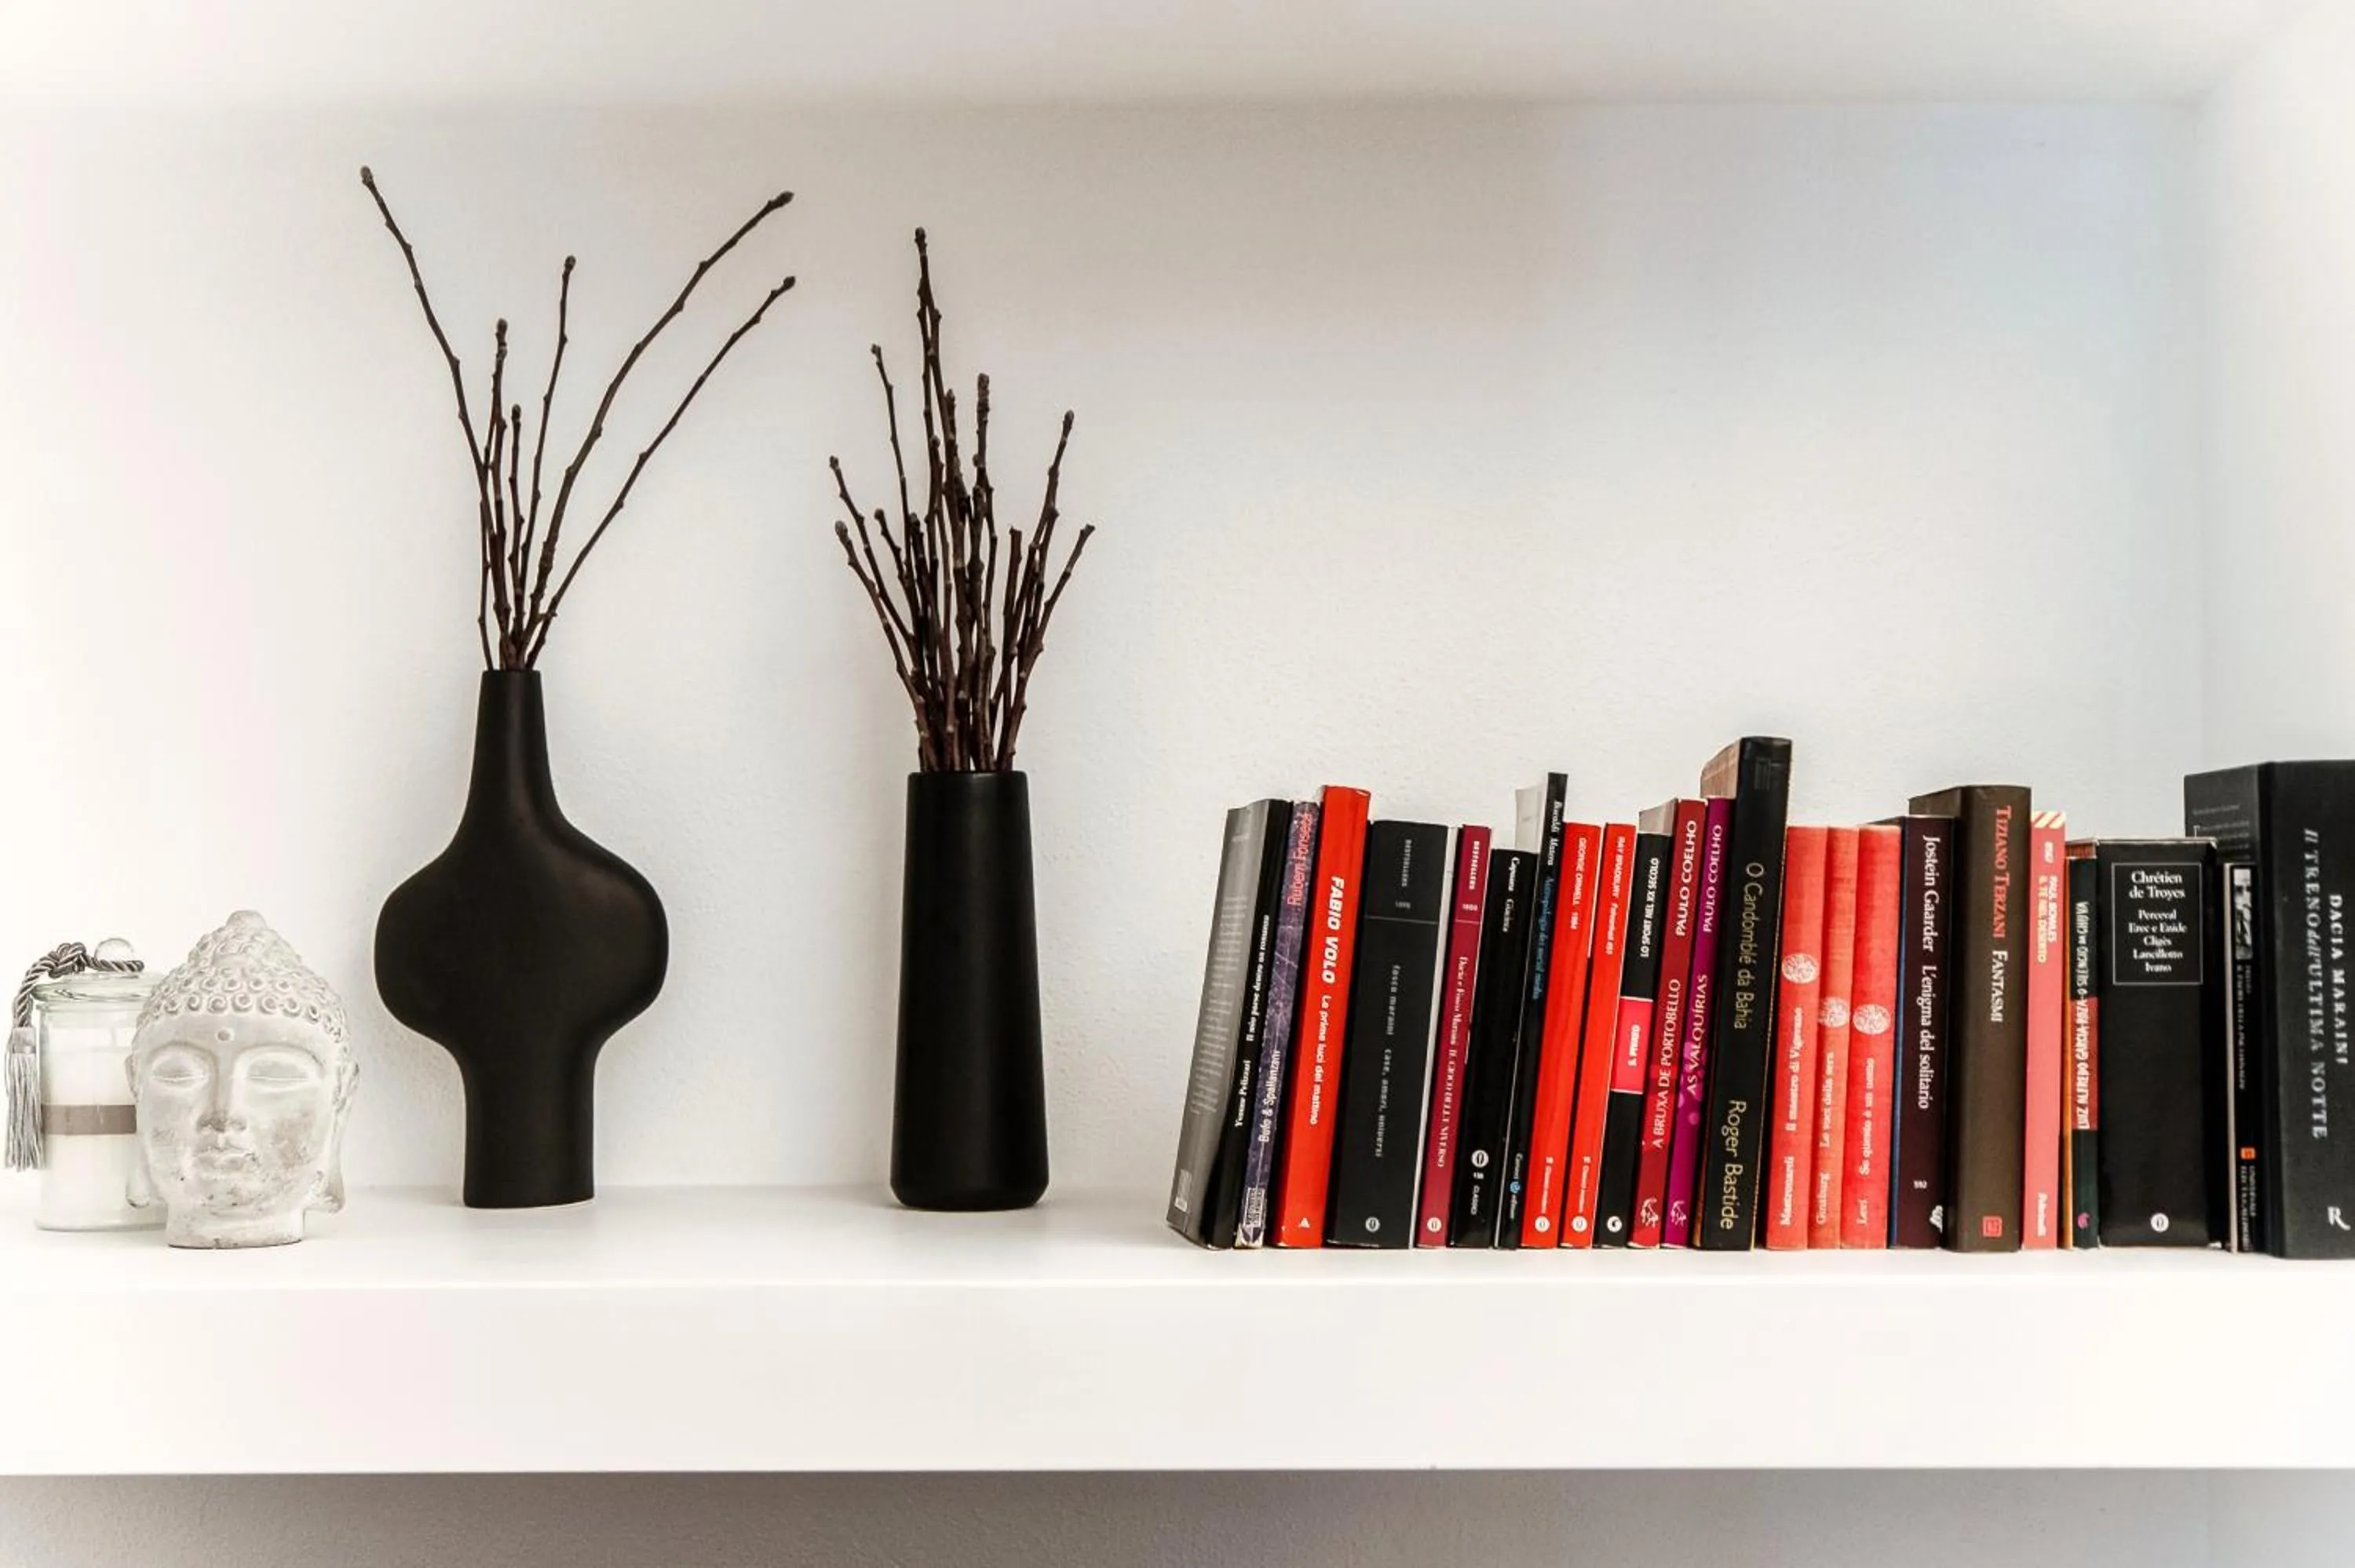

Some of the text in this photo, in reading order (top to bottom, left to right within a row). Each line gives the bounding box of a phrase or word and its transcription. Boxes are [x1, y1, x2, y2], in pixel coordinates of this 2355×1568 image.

[1287, 812, 1313, 906] Rubem Fonseca
[1640, 858, 1659, 957] LO SPORT NEL XX SECOLO
[1675, 820, 1696, 936] PAULO COELHO
[1703, 825, 1722, 932] PAULO COELHO
[1993, 805, 2012, 939] TIZIANO TERZANI
[2129, 885, 2185, 901] de Troyes
[2131, 870, 2182, 884] Chrétien
[2304, 849, 2321, 928] TRENO
[1322, 876, 1344, 984] FABIO VOLO
[1734, 862, 1764, 1030] O Candomblé da Bahia
[2138, 909, 2177, 920] Perceval
[1916, 835, 1941, 1109] Jostein Gaarder L'enigma del solitario
[1991, 950, 2008, 1022] FANTASMI
[2145, 961, 2172, 972] Ivano
[2328, 894, 2349, 1065] DACIA MARAINI
[1309, 995, 1331, 1125] Le prime luci del mattino
[1652, 979, 1681, 1149] A BRUXA DE PORTOBELLO
[1686, 975, 1707, 1096] AS VALQUÍRIAS
[2076, 1061, 2090, 1104] ALFREDO
[1263, 1107, 1273, 1118] &
[2076, 1106, 2090, 1129] LUIZ
[2310, 1062, 2328, 1138] NOTTE
[1720, 1099, 1747, 1231] Roger Bastide
